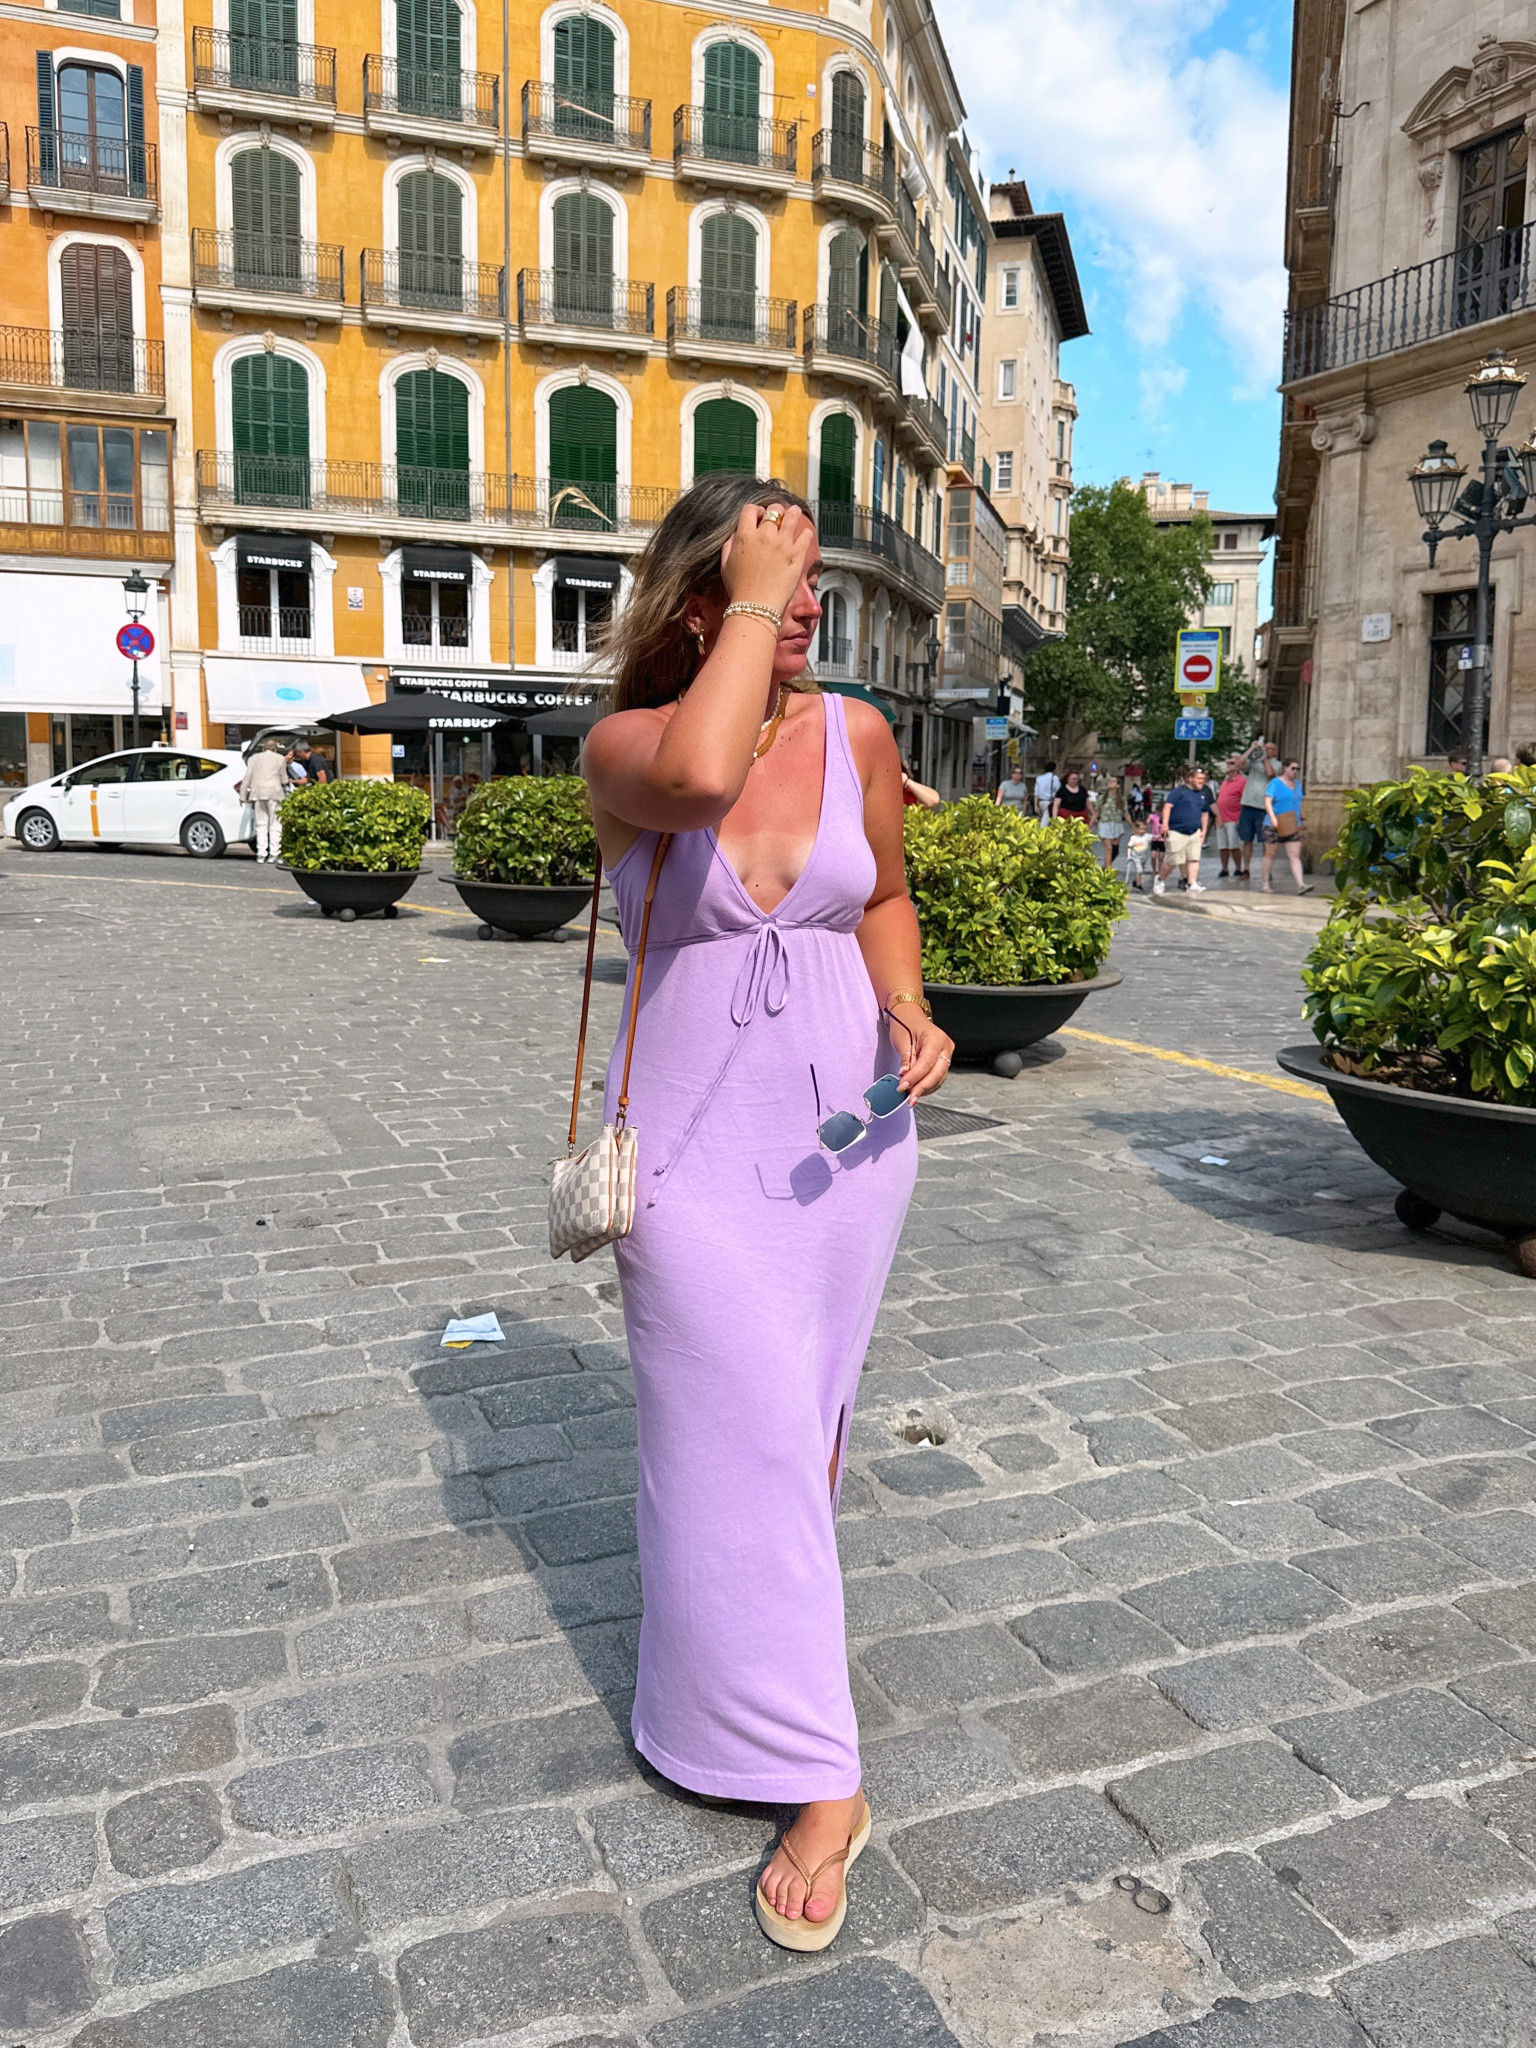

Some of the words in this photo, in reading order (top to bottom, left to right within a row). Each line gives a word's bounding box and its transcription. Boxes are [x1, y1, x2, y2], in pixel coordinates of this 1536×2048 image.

[247, 555, 303, 568] STARBUCKS
[413, 569, 465, 580] STARBUCKS
[565, 578, 613, 589] STARBUCKS
[399, 677, 454, 687] STARBUCKS
[455, 680, 489, 688] COFFEE
[428, 717, 502, 728] STARBUCK
